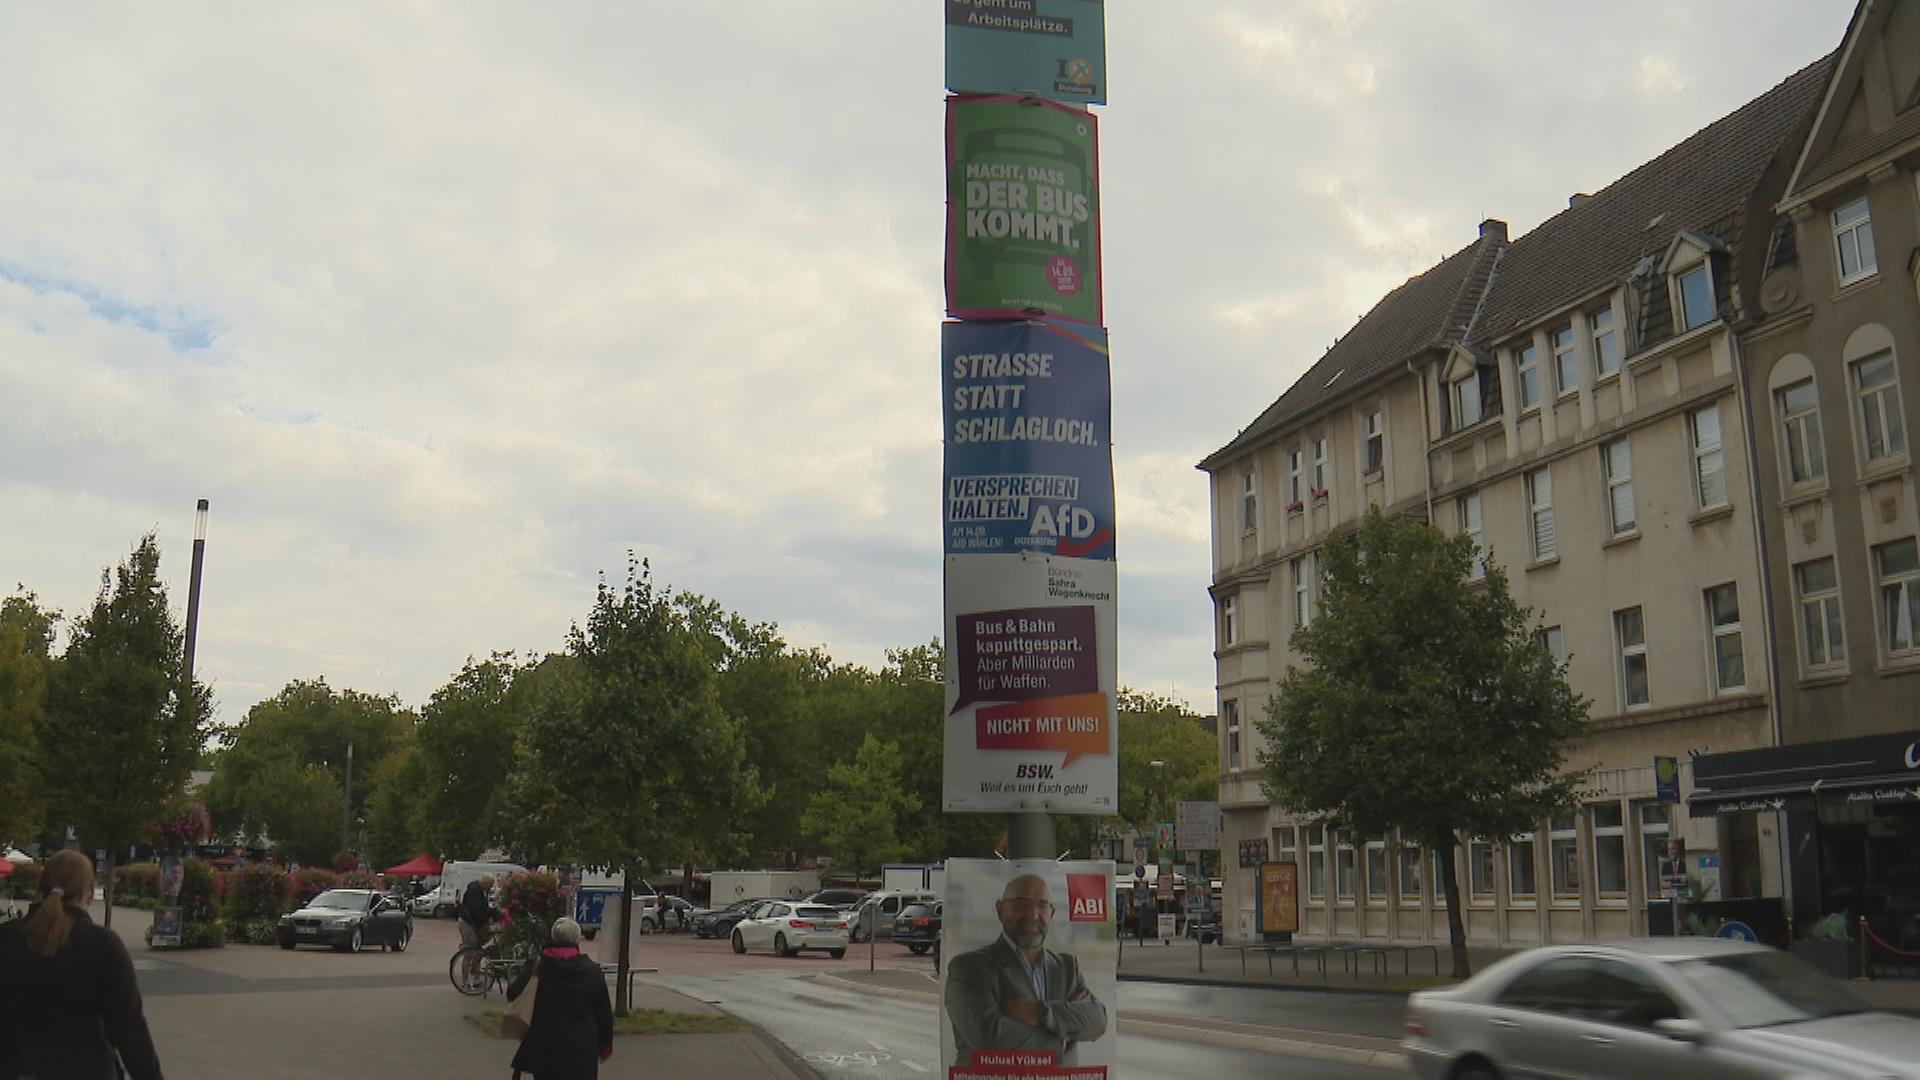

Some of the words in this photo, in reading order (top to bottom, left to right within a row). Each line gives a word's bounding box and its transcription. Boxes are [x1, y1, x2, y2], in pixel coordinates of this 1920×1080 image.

[1010, 0, 1031, 10] um
[968, 12, 1068, 32] Arbeitsplätze.
[966, 163, 1024, 180] MACHT,
[1028, 167, 1064, 185] DASS
[966, 181, 1029, 209] DER
[1036, 184, 1088, 222] BUS
[966, 209, 1080, 248] KOMMT.
[953, 353, 1053, 379] STRASSE
[954, 385, 1025, 411] STATT
[955, 417, 1098, 446] SCHLAGLOCH.
[952, 477, 1076, 498] VERSPRECHEN
[951, 499, 1025, 520] HALTEN.
[1029, 503, 1095, 538] AfD
[952, 527, 965, 537] AM
[1014, 536, 1057, 546] DUISBURG
[1048, 577, 1076, 588] Sahra
[1048, 587, 1110, 601] Wagenknecht
[976, 620, 1002, 635] Bus
[1006, 619, 1016, 633] &
[1019, 619, 1056, 633] Bahn
[976, 636, 1082, 655] kaputtgespart.
[977, 655, 1008, 672] Aber
[1012, 655, 1075, 670] Milliarden
[977, 674, 995, 691] für
[1000, 673, 1051, 690] Waffen.
[987, 717, 1031, 735] NICHT
[1036, 717, 1064, 733] MIT
[1067, 716, 1099, 733] UNS!
[1016, 764, 1054, 779] BSW.
[980, 781, 1001, 793] Weil
[1004, 784, 1015, 793] es
[1018, 783, 1034, 793] um
[1037, 782, 1061, 794] Euch
[1064, 783, 1088, 796] geht!
[1073, 897, 1104, 914] ABI
[980, 1055, 1014, 1065] Hulusi
[1017, 1055, 1051, 1065] Yüksel
